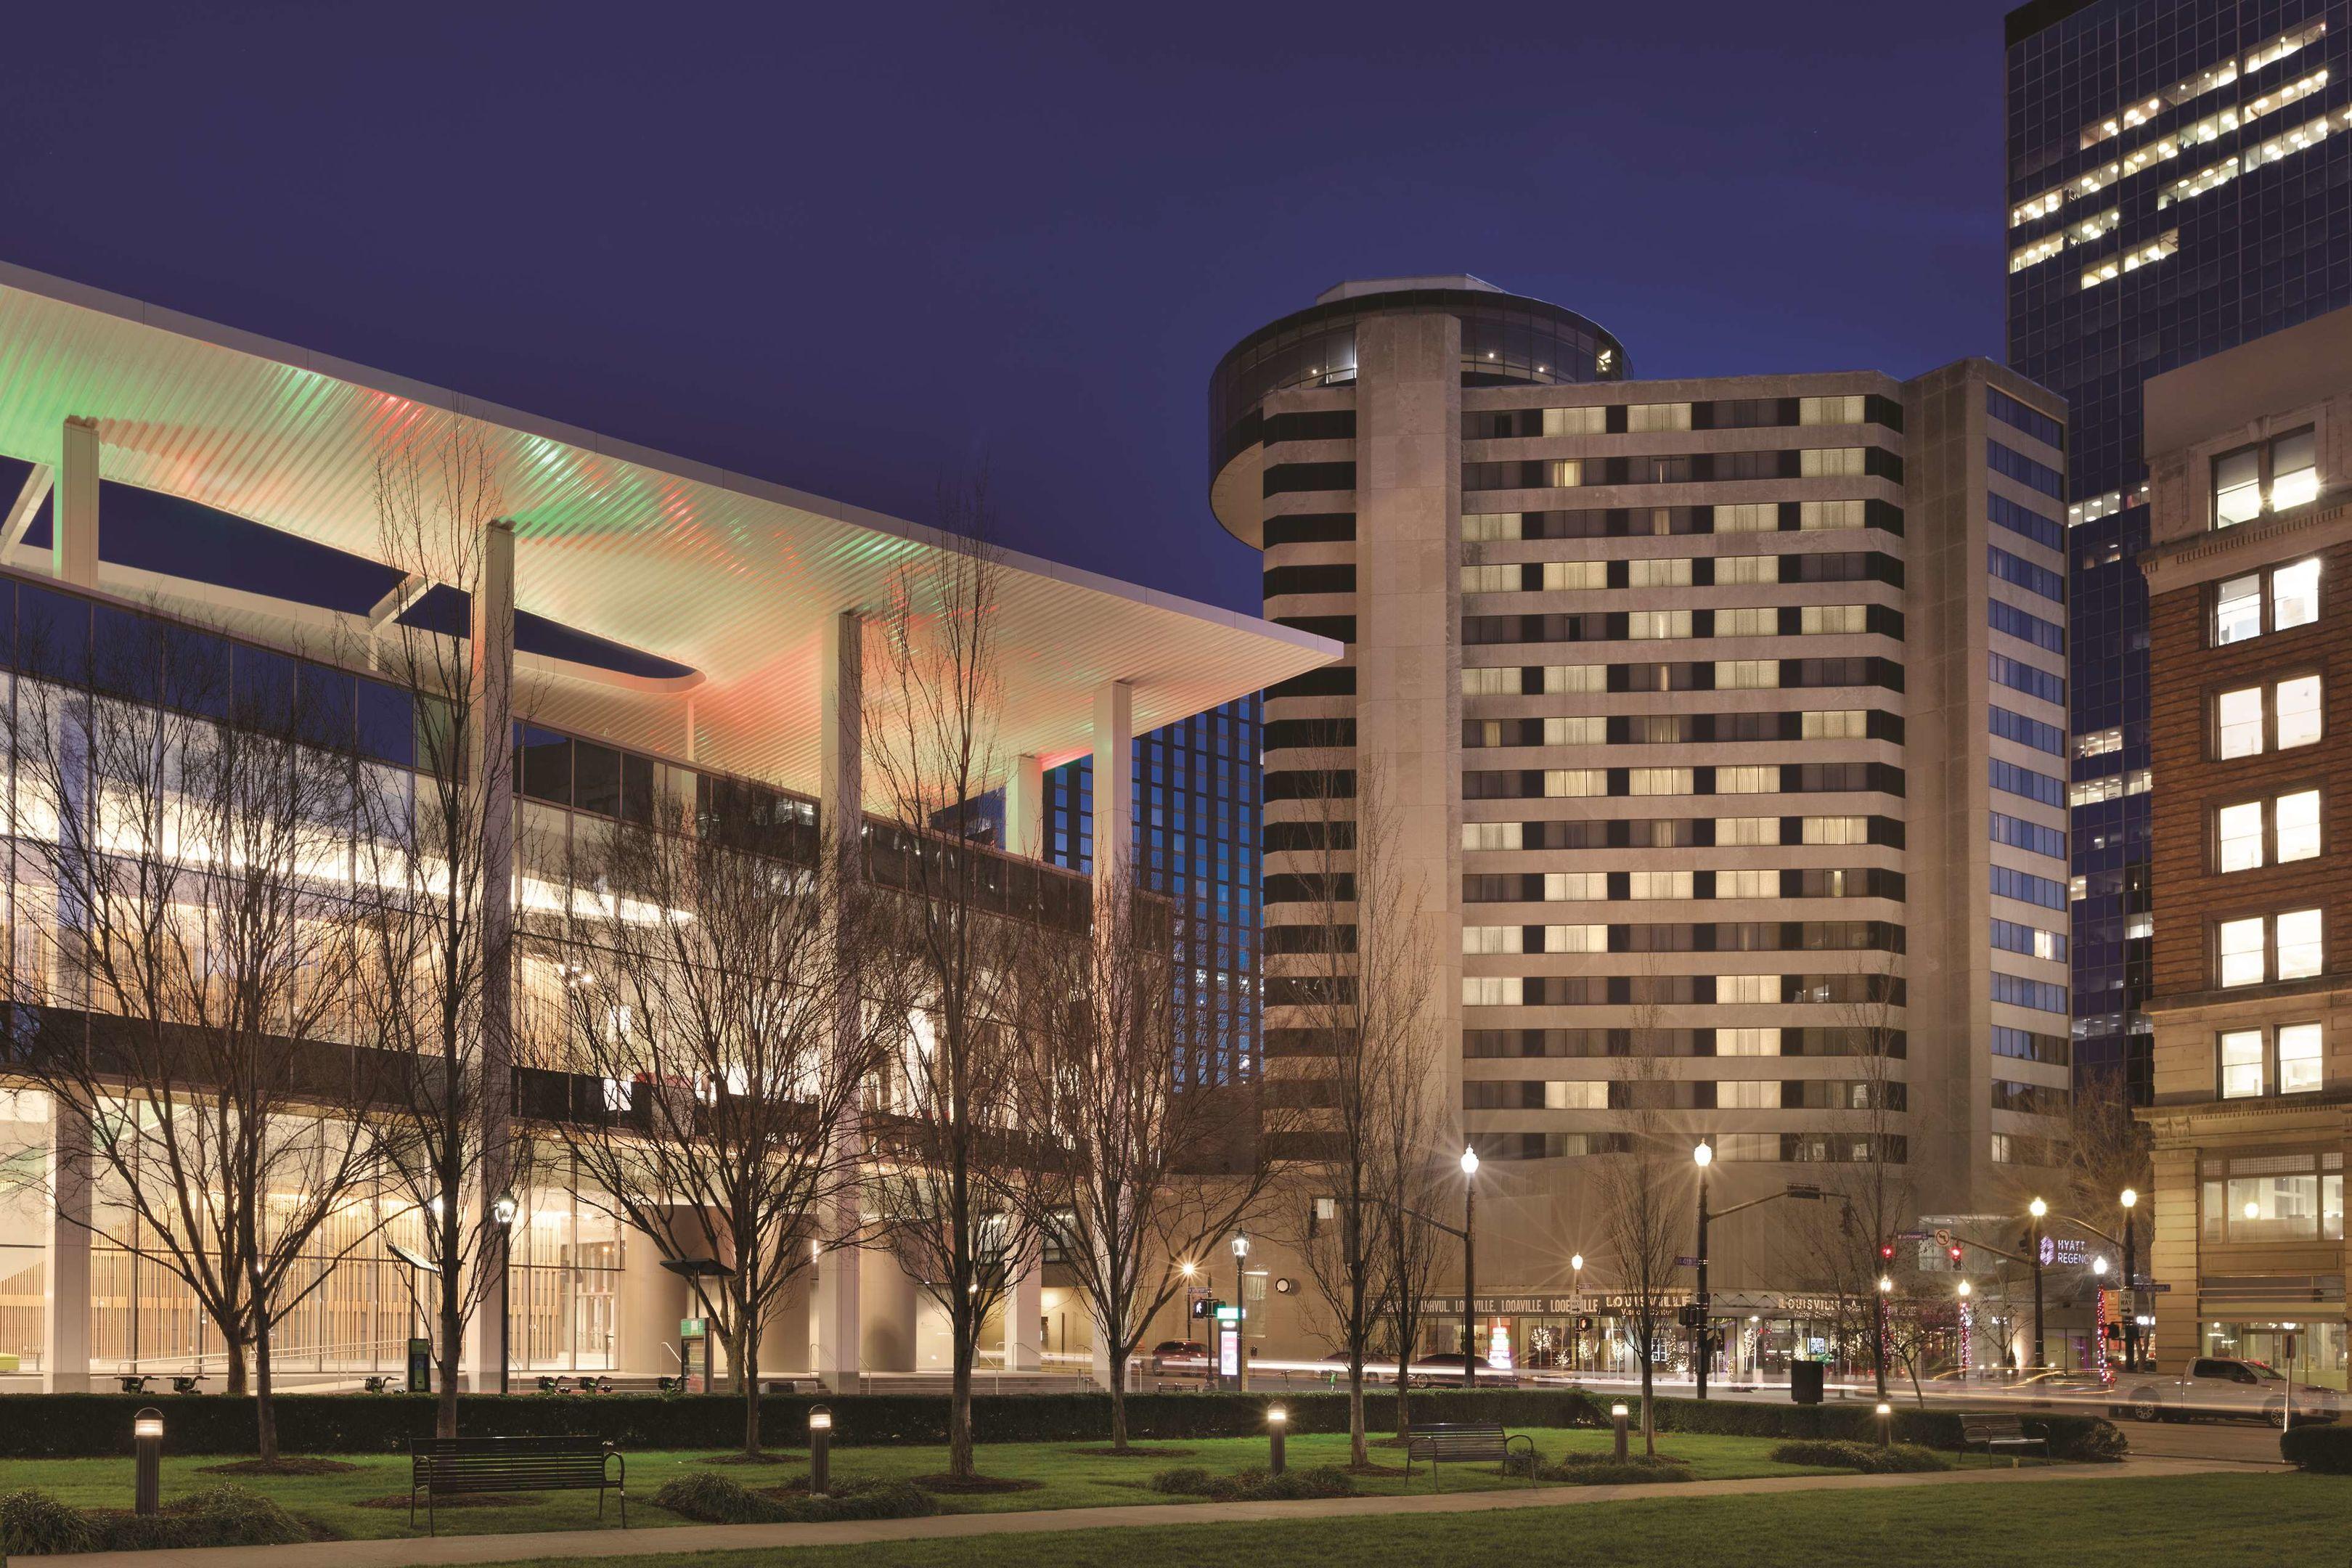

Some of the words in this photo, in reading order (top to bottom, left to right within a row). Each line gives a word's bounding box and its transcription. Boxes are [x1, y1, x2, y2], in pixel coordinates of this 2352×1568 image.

[2058, 1240, 2086, 1251] HYATT
[2058, 1253, 2092, 1265] REGENC
[1455, 1300, 1495, 1312] LOVILLE.
[1501, 1299, 1543, 1312] LOOAVILLE.
